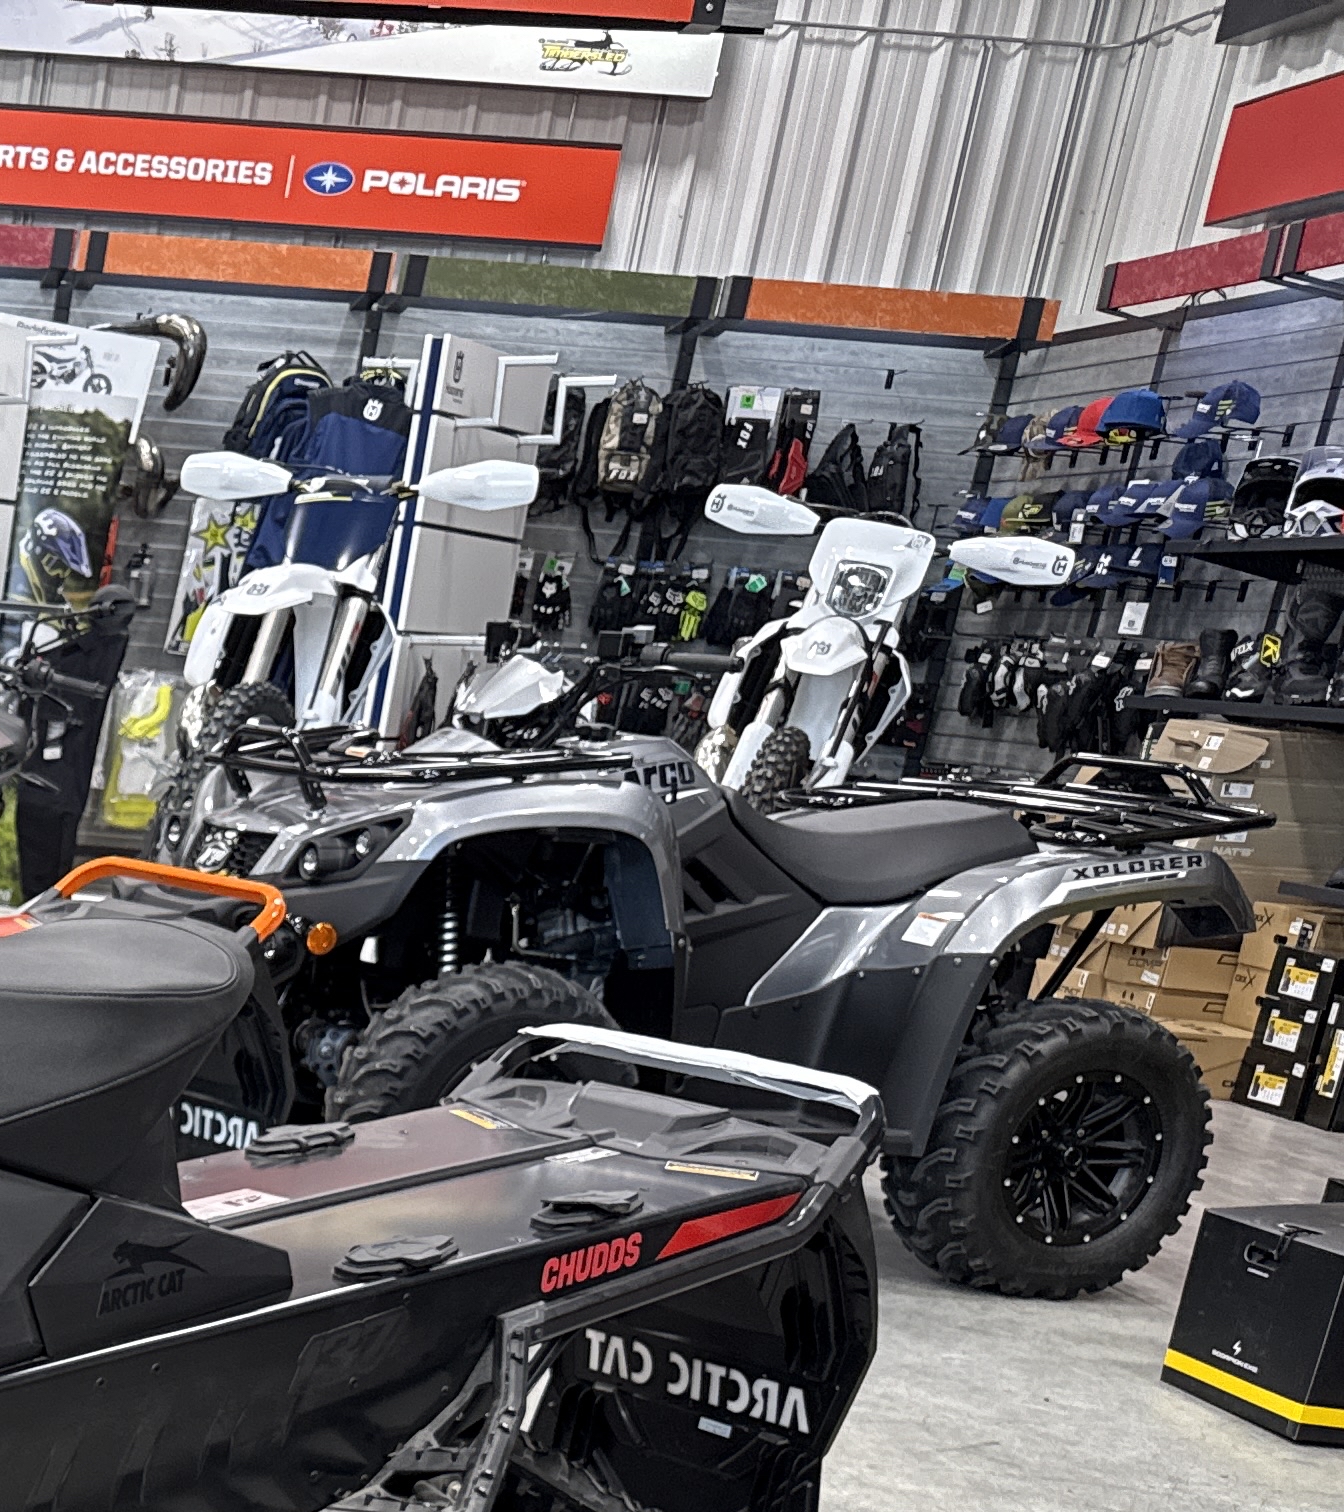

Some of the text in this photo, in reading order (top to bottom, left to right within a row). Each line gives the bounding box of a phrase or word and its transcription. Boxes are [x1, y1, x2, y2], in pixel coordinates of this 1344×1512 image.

[55, 148, 76, 173] &
[78, 149, 273, 186] ACCESSORIES
[361, 168, 523, 203] POLARIS
[737, 422, 754, 449] FOX
[608, 468, 637, 482] FOX
[1072, 855, 1204, 880] XPLORER
[540, 1231, 643, 1294] CHUDDS
[99, 1267, 186, 1316] ARCTIC CAT
